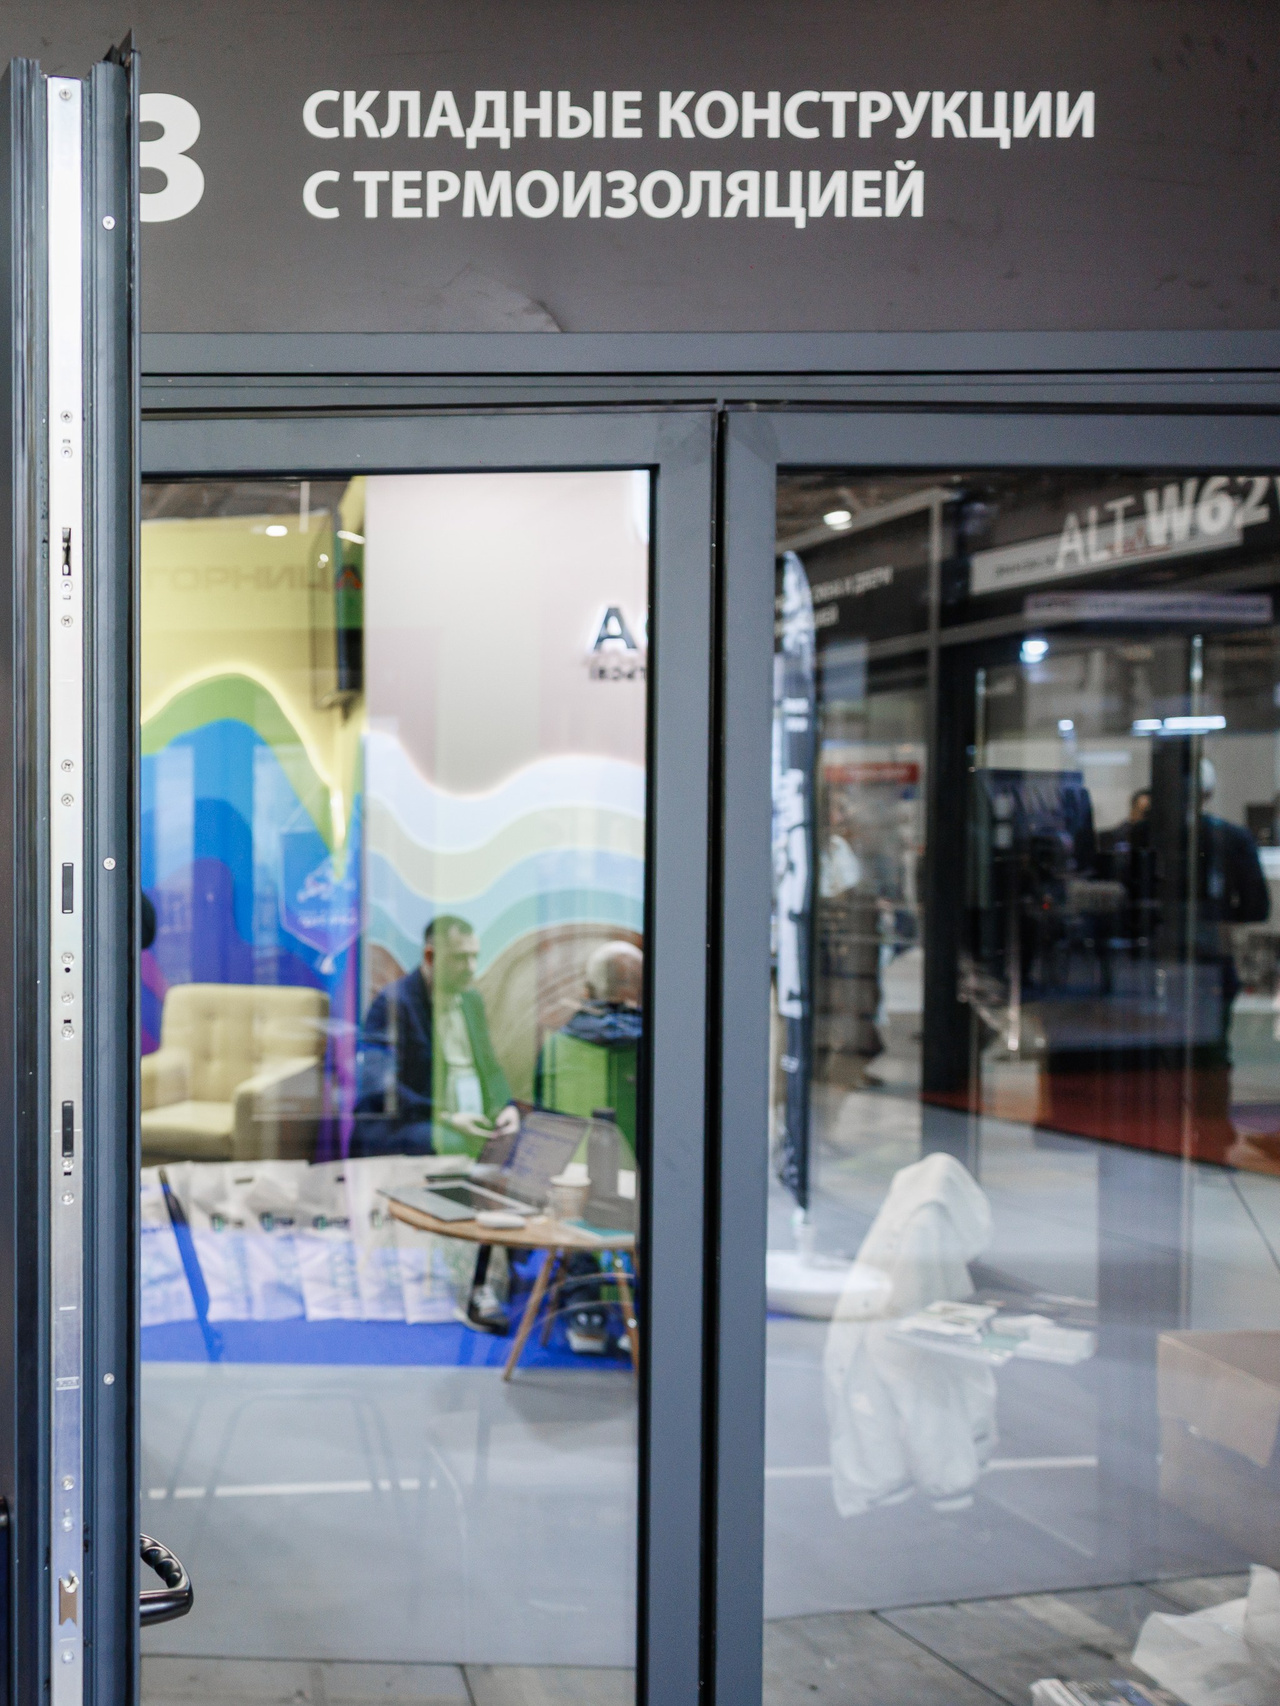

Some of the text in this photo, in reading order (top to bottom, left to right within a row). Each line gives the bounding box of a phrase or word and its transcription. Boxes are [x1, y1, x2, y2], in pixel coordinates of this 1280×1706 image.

[302, 89, 1095, 150] СКЛАДНЫЕ КОНСТРУКЦИИ
[302, 160, 925, 228] С ТЕРМОИЗОЛЯЦИЕЙ
[1055, 495, 1136, 571] ALT
